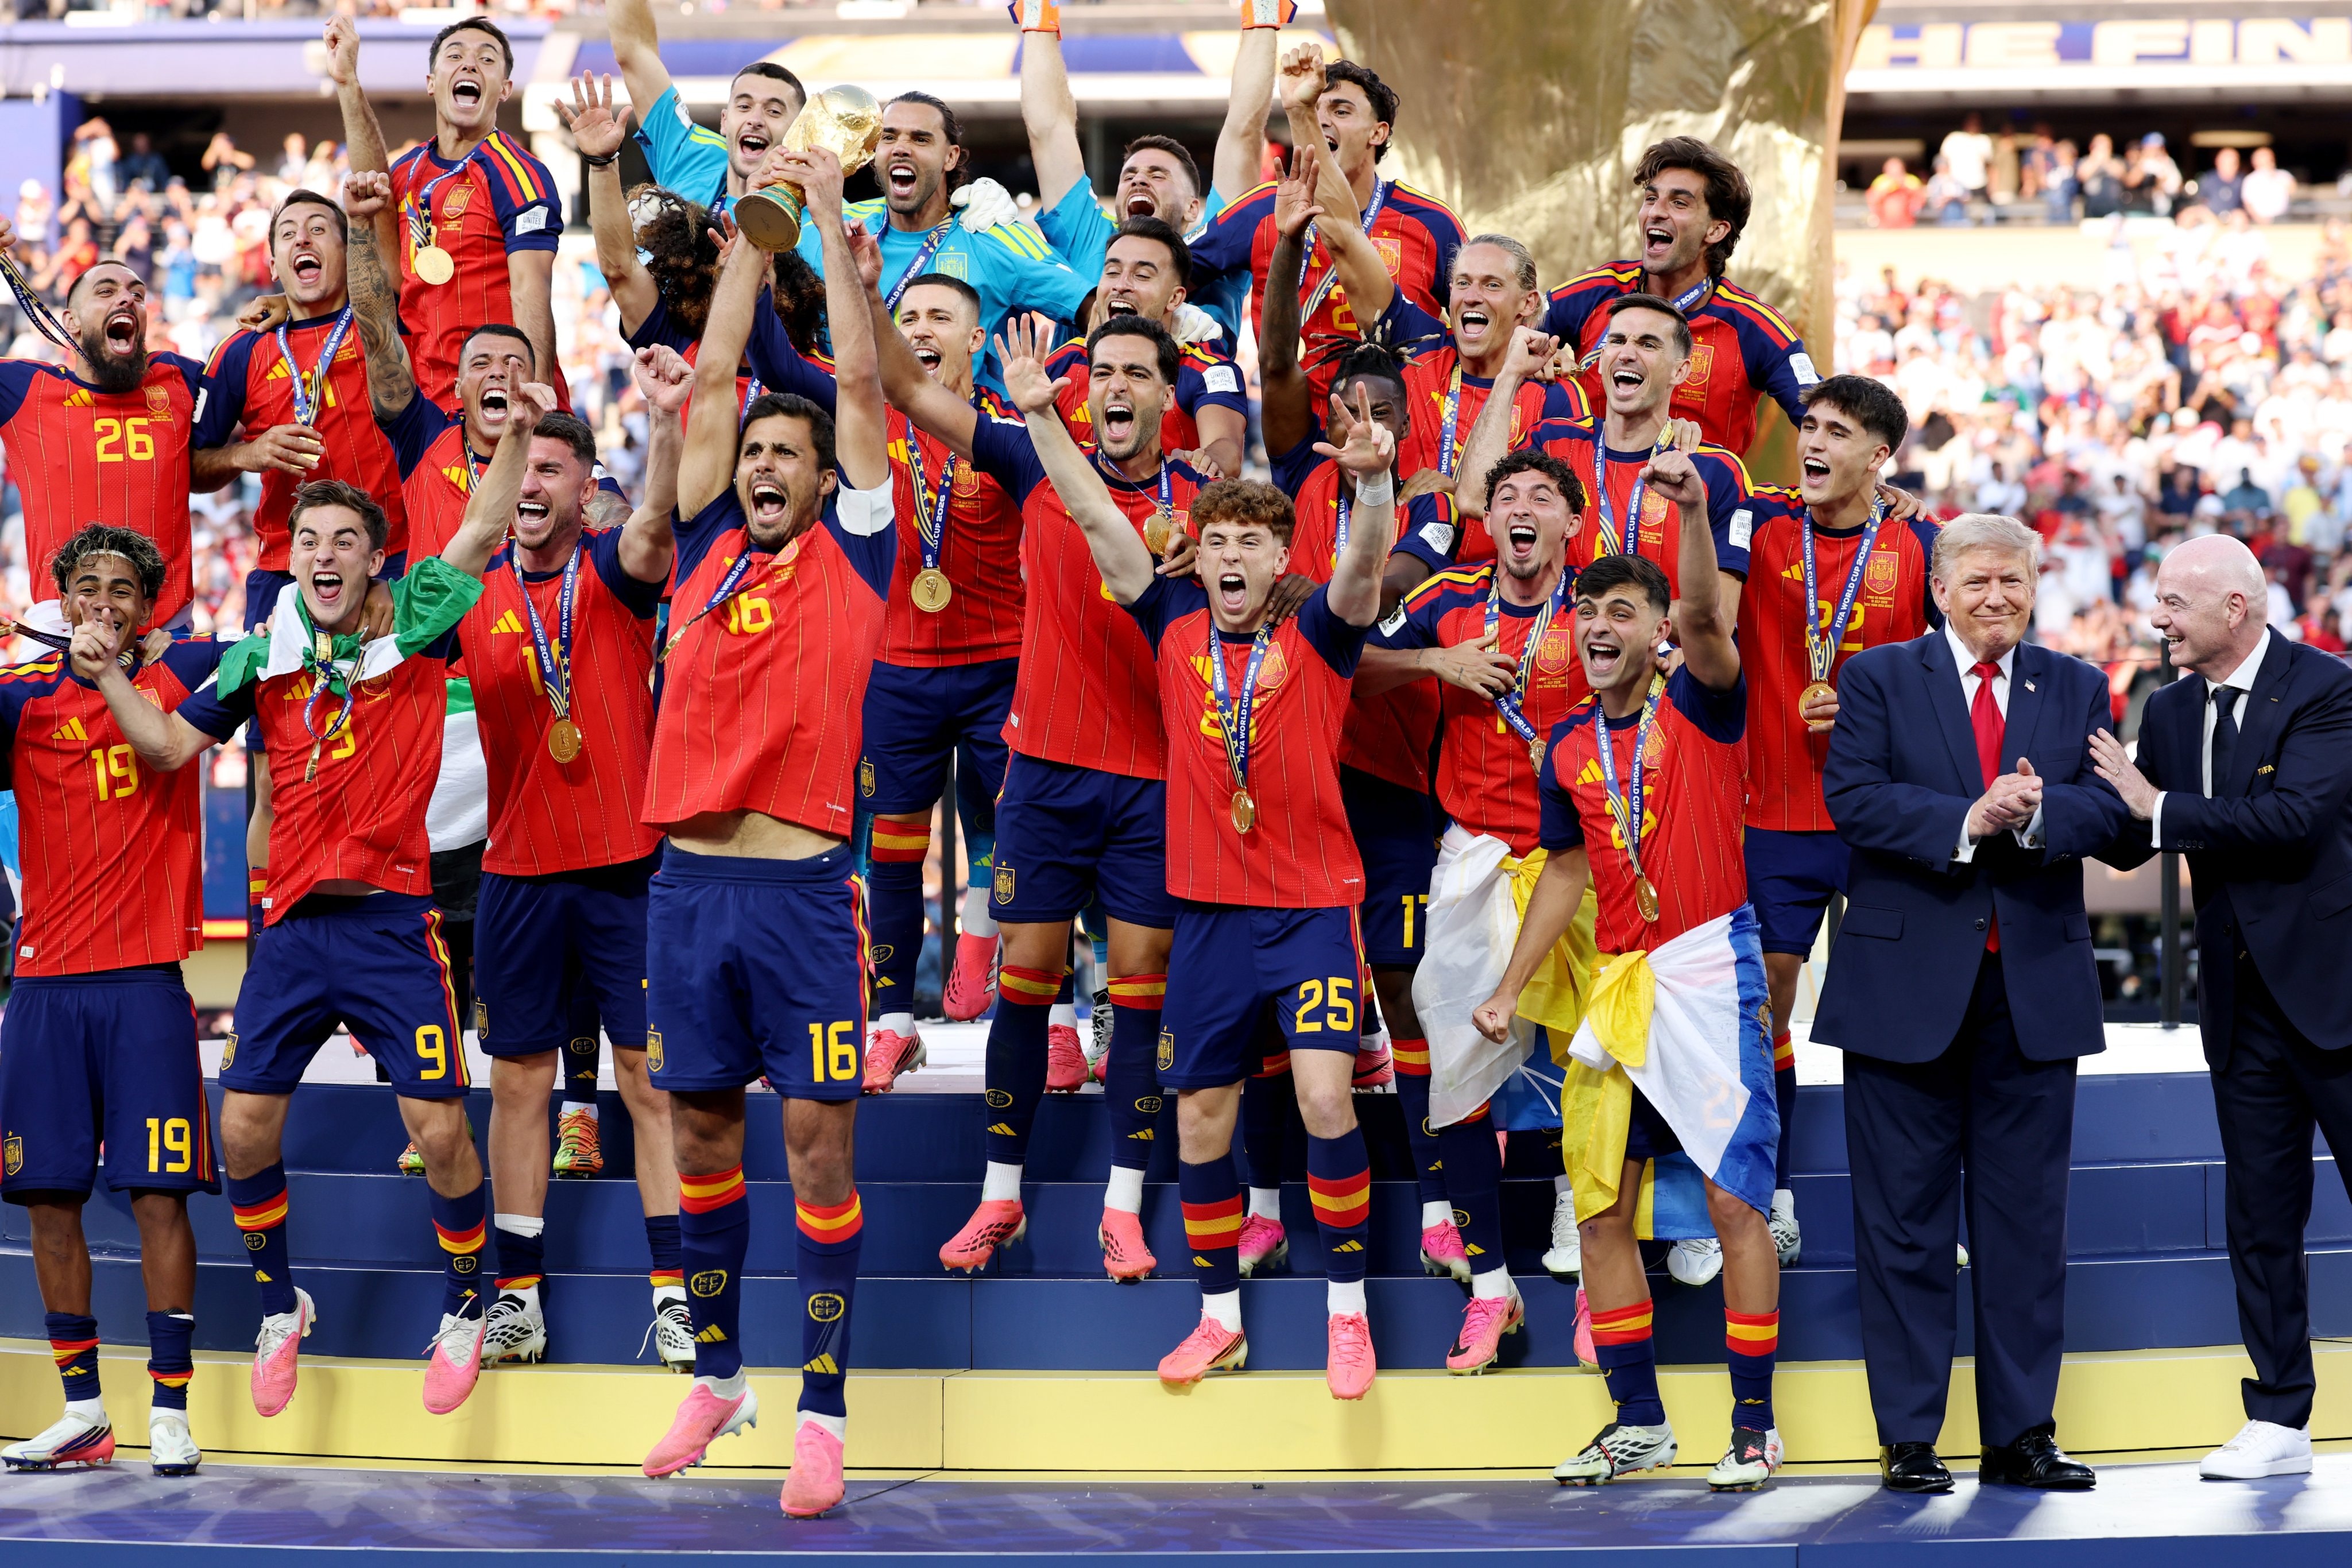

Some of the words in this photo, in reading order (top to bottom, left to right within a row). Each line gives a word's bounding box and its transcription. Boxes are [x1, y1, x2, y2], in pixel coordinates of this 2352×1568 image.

[1854, 21, 2061, 67] HE
[452, 162, 463, 172] CUP
[523, 216, 541, 224] UNITES
[712, 202, 721, 216] FIFA
[1363, 217, 1372, 231] FIFA
[1368, 189, 1382, 218] WORLD
[886, 291, 900, 309] ORLD
[907, 255, 926, 278] 2026
[1299, 259, 1307, 287] 2026
[13, 285, 24, 299] FIFA
[21, 299, 37, 322] WORLD
[35, 320, 45, 331] CUP
[1680, 289, 1700, 304] 2026
[324, 341, 336, 357] FIFA
[332, 319, 347, 342] WORLD
[343, 308, 352, 320] CUP
[278, 338, 292, 363] WORLD
[294, 378, 302, 400] 2026
[94, 417, 154, 462] 26
[1442, 434, 1451, 451] FIFA
[1631, 486, 1641, 514] 2026
[1433, 524, 1449, 544] UNITES
[1737, 521, 1751, 532] UNITE
[1856, 538, 1870, 566] 2026
[564, 573, 572, 590] CUP
[721, 571, 739, 594] WORLD
[736, 559, 747, 572] CUP
[1850, 566, 1860, 582] CUP
[726, 583, 772, 635] 16
[1840, 582, 1855, 611] WORLD
[1835, 610, 1846, 628] FIFA
[529, 599, 539, 629] WORLD
[535, 628, 544, 645] CUP
[540, 645, 552, 673] 2026
[1214, 663, 1224, 692] 2026
[1245, 661, 1257, 690] 2026
[336, 700, 351, 727] 2026
[1498, 697, 1509, 713] FIFA
[1507, 710, 1531, 737] WORLD
[325, 710, 355, 760] 9
[91, 744, 138, 801] 19
[1603, 751, 1613, 781] 2026
[1633, 764, 1641, 795] WORLD
[2257, 765, 2274, 776] FIFA
[1402, 895, 1429, 947] 1
[1295, 977, 1353, 1033] 25
[415, 1025, 446, 1080] 9
[809, 1021, 857, 1082] 16
[146, 1118, 191, 1173] 19
